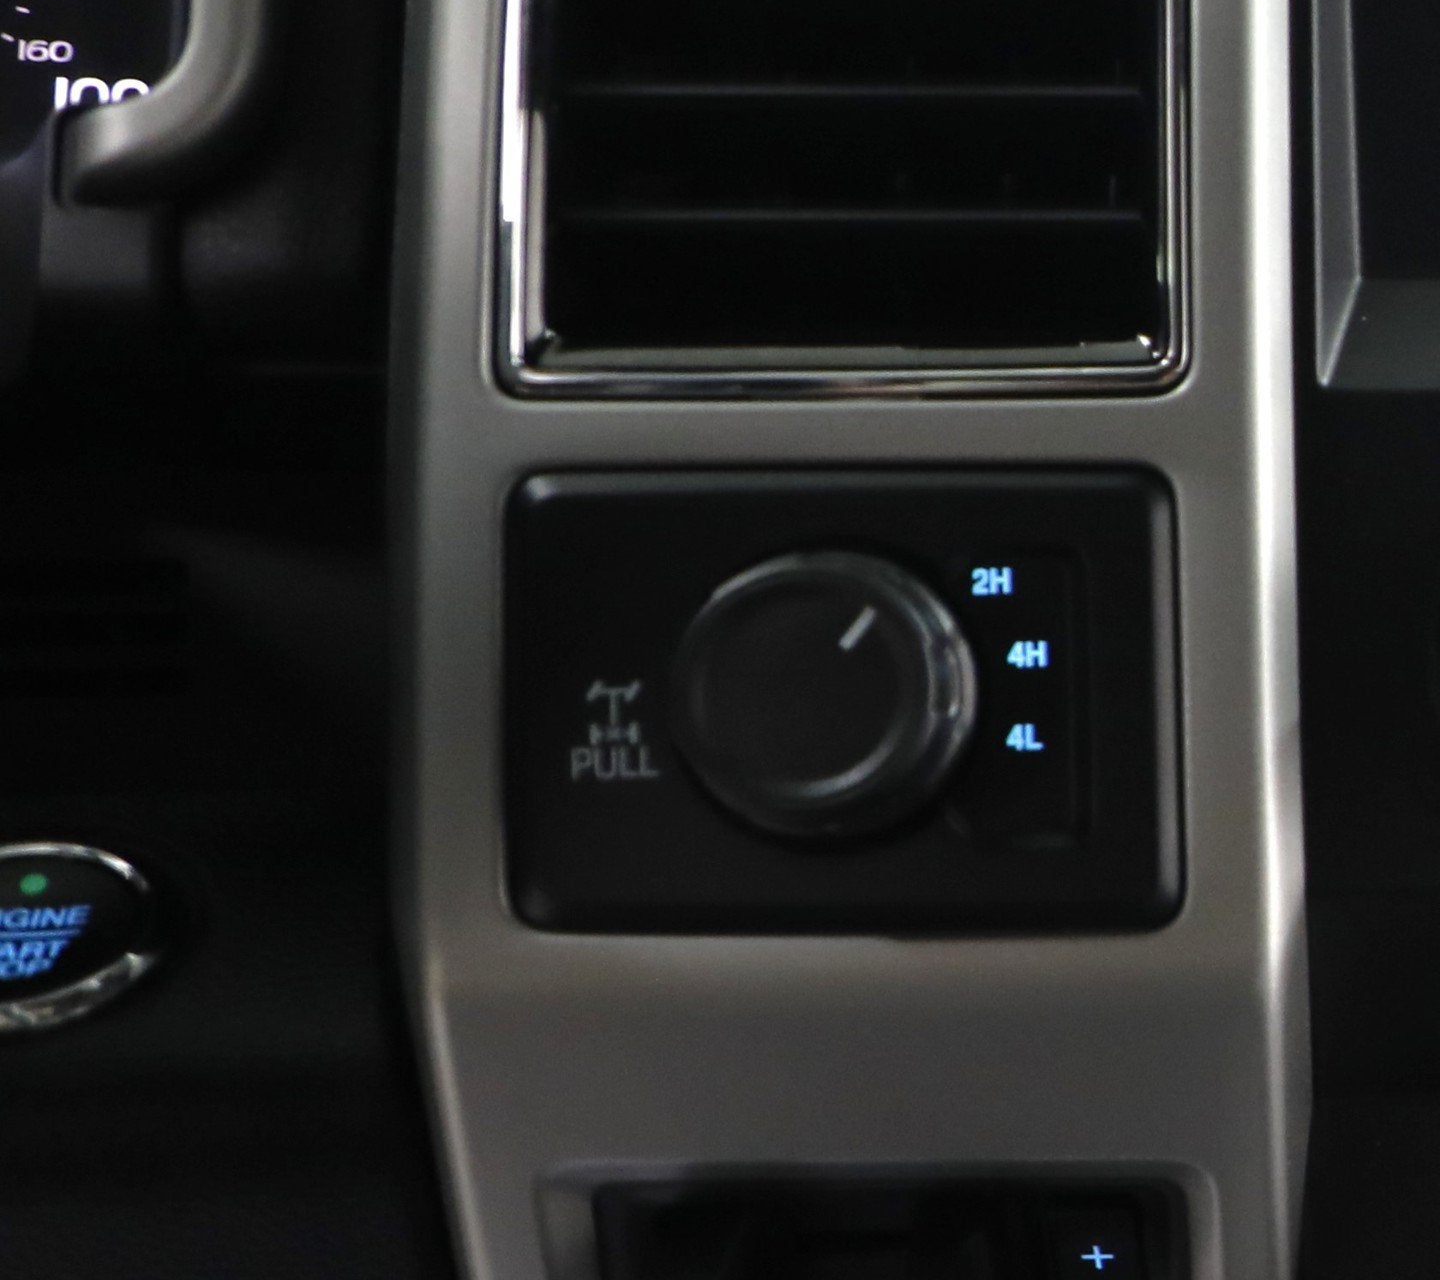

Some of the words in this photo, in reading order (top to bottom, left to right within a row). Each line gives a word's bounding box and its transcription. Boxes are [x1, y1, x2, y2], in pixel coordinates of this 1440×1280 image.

[17, 39, 74, 63] 160
[971, 566, 1014, 596] 2H
[1006, 640, 1049, 669] 4H
[1005, 723, 1045, 751] 4L
[571, 749, 659, 780] PULL
